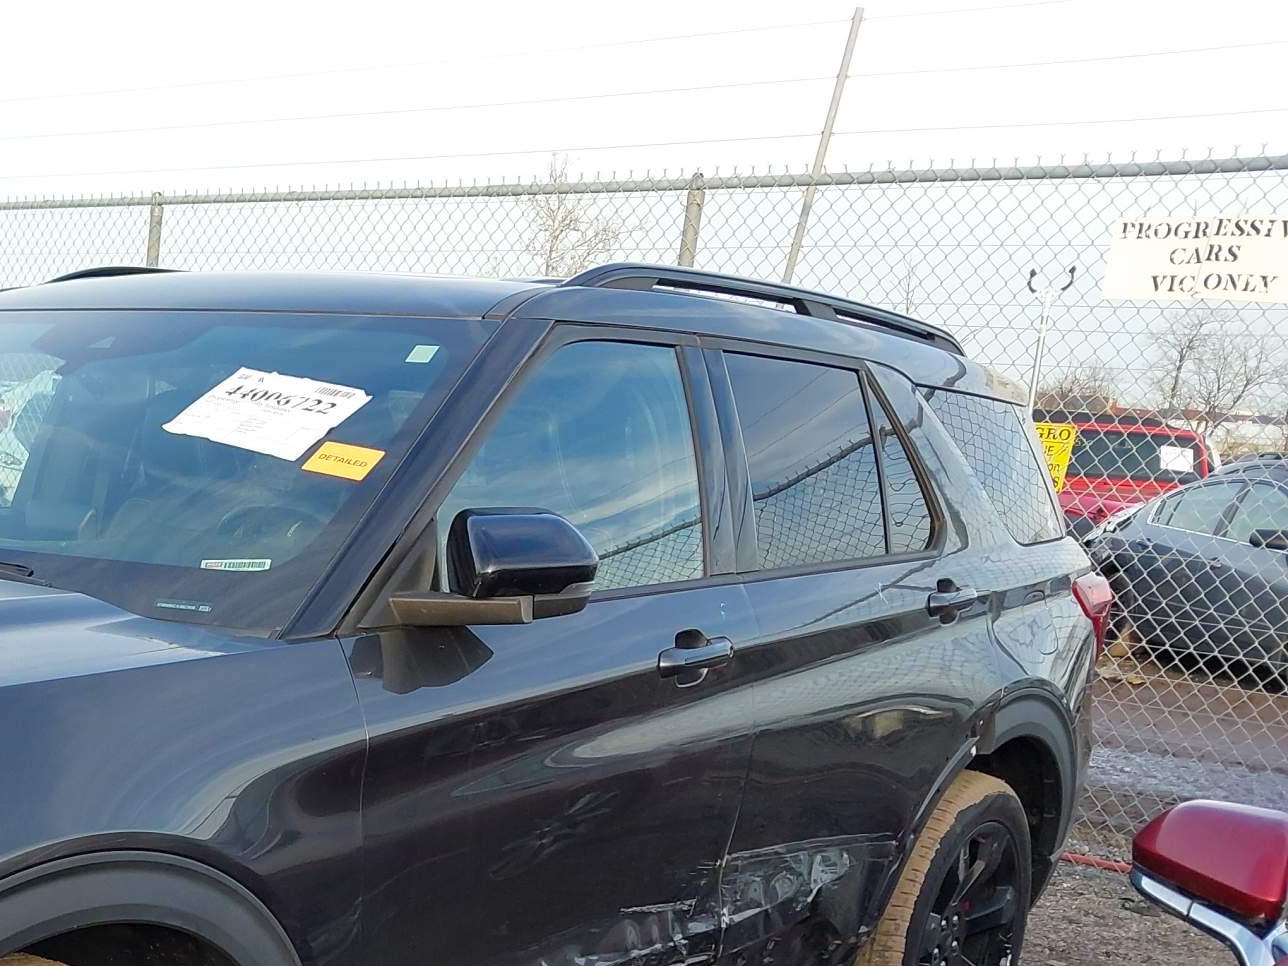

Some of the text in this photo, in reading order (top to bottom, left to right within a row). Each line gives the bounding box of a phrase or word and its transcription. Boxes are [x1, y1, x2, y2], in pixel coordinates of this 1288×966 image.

[1169, 244, 1241, 265] CARS
[1151, 273, 1279, 294] VIC ONLY
[318, 452, 368, 469] DETAILED
